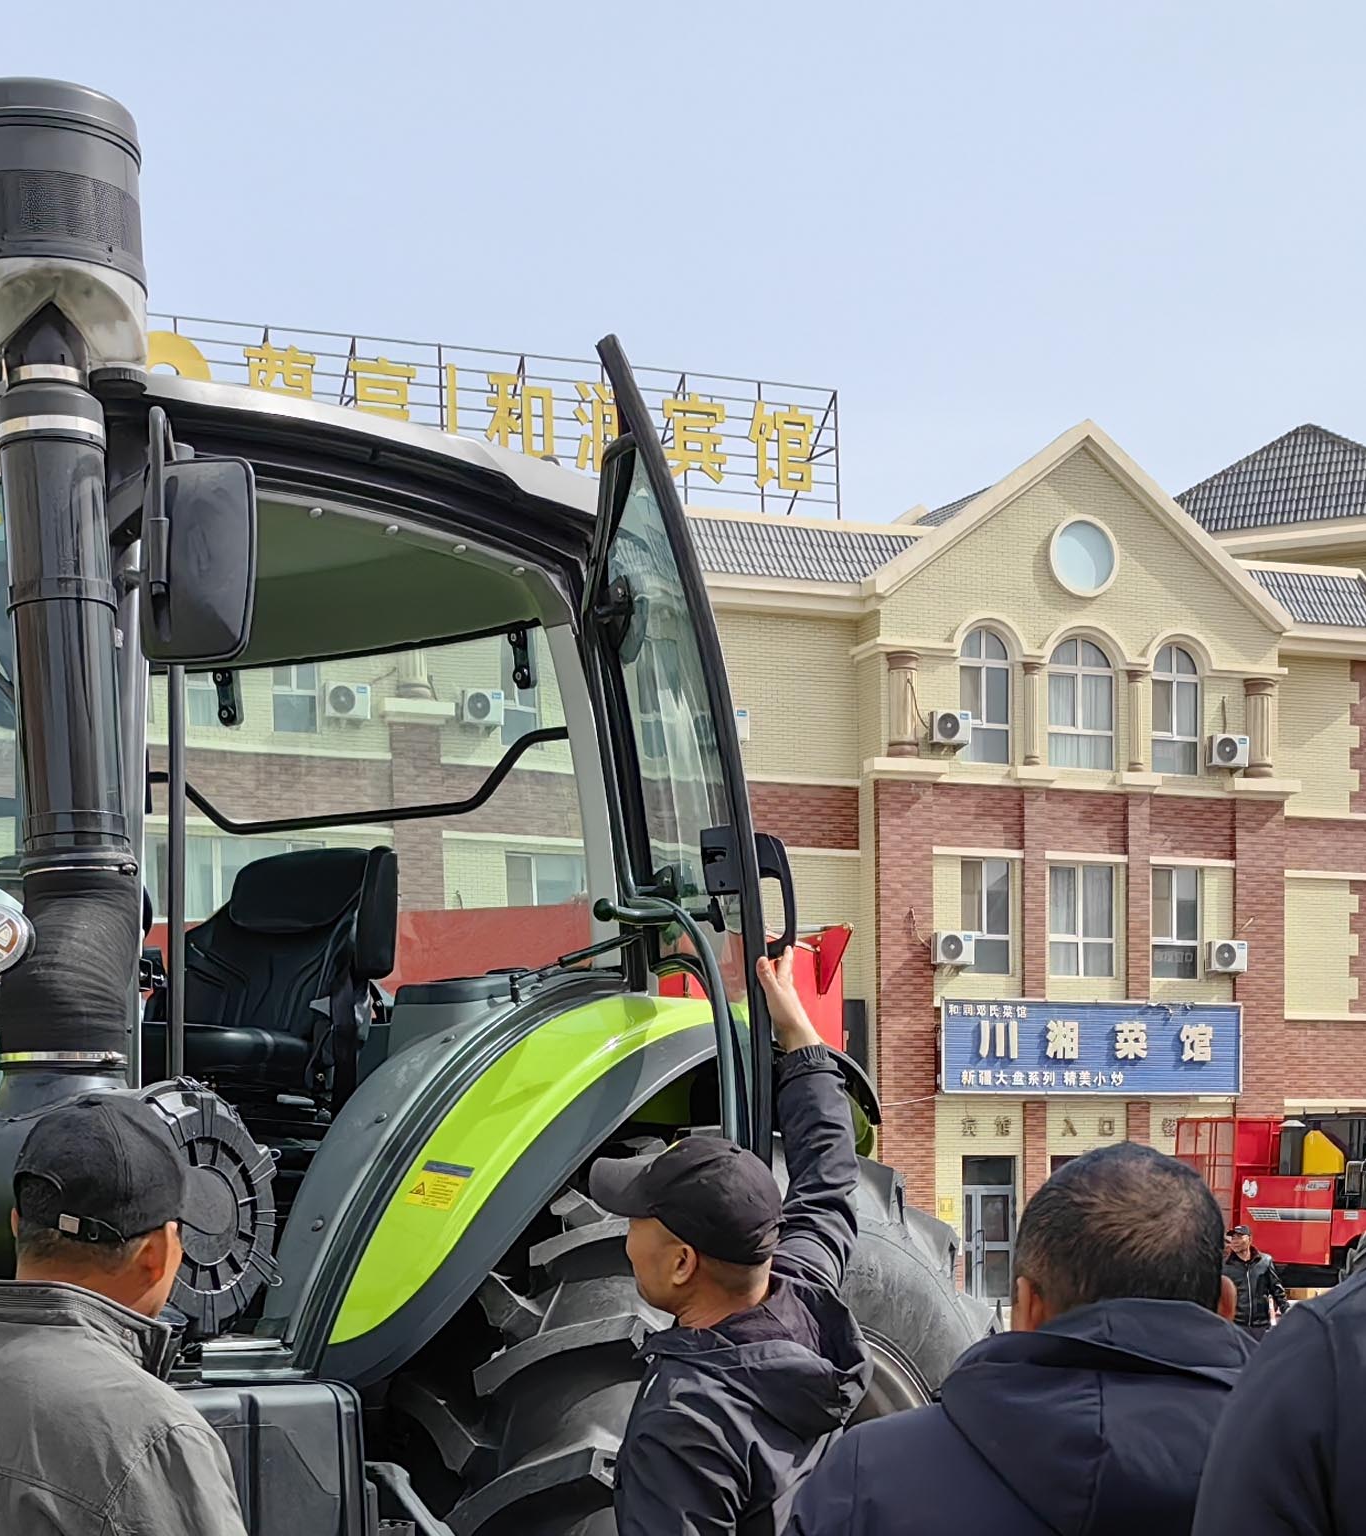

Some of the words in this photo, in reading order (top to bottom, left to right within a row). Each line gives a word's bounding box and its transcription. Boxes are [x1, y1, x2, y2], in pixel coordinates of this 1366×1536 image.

[979, 1020, 1214, 1062] 川湘菜馆
[961, 1070, 1056, 1087] 新疆大盘系列
[1063, 1070, 1124, 1087] 精美小炒
